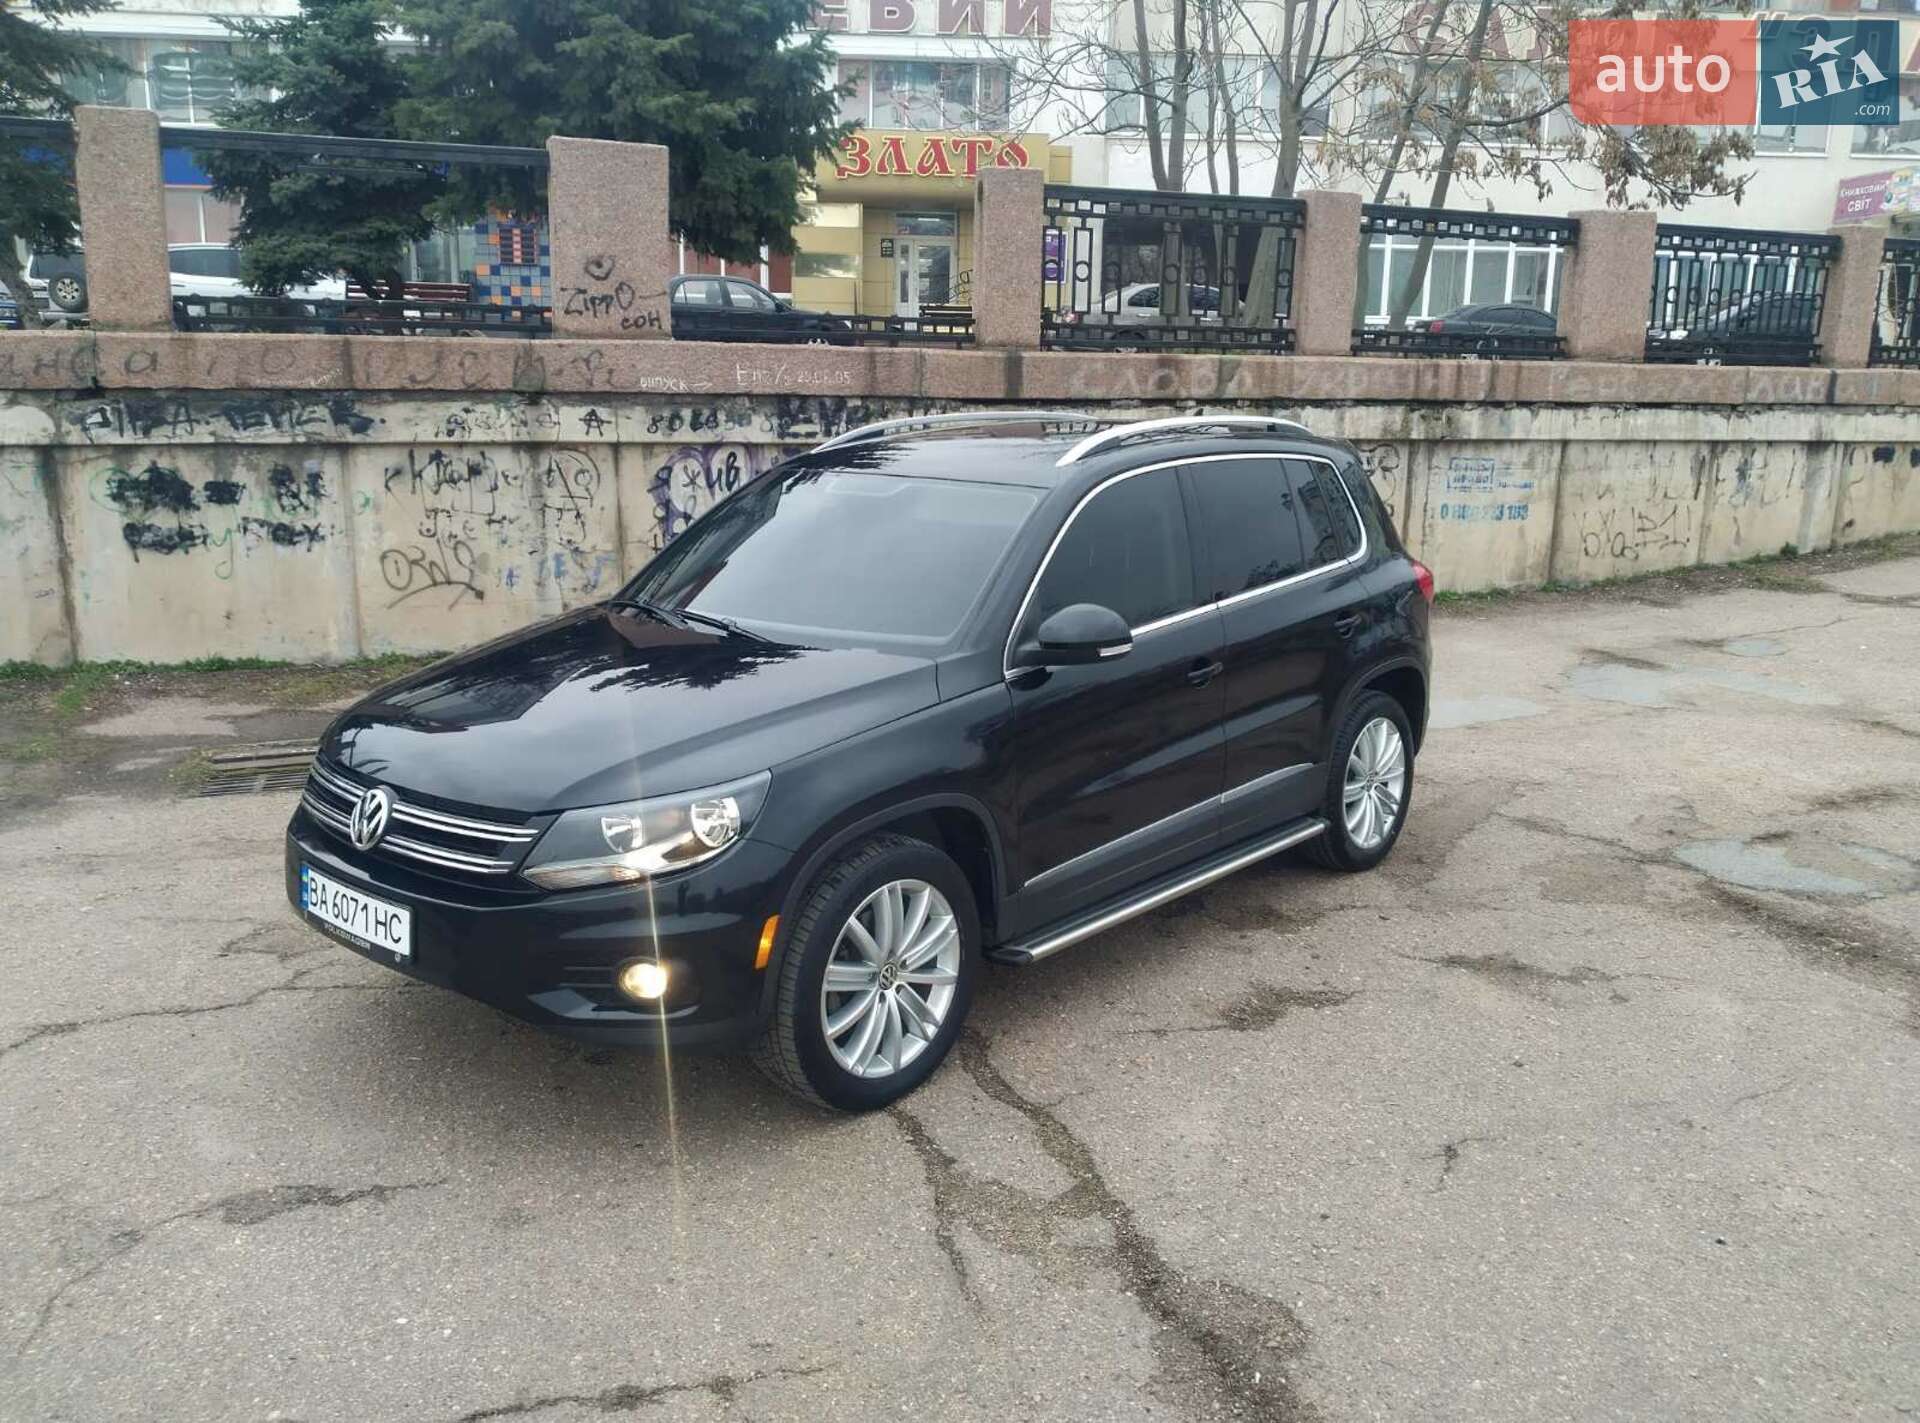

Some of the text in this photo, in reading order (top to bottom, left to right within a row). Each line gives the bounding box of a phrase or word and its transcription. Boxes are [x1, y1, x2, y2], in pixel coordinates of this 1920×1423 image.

[835, 135, 1029, 180] ЗЛАТО
[310, 877, 401, 944] BA 6071 HC
